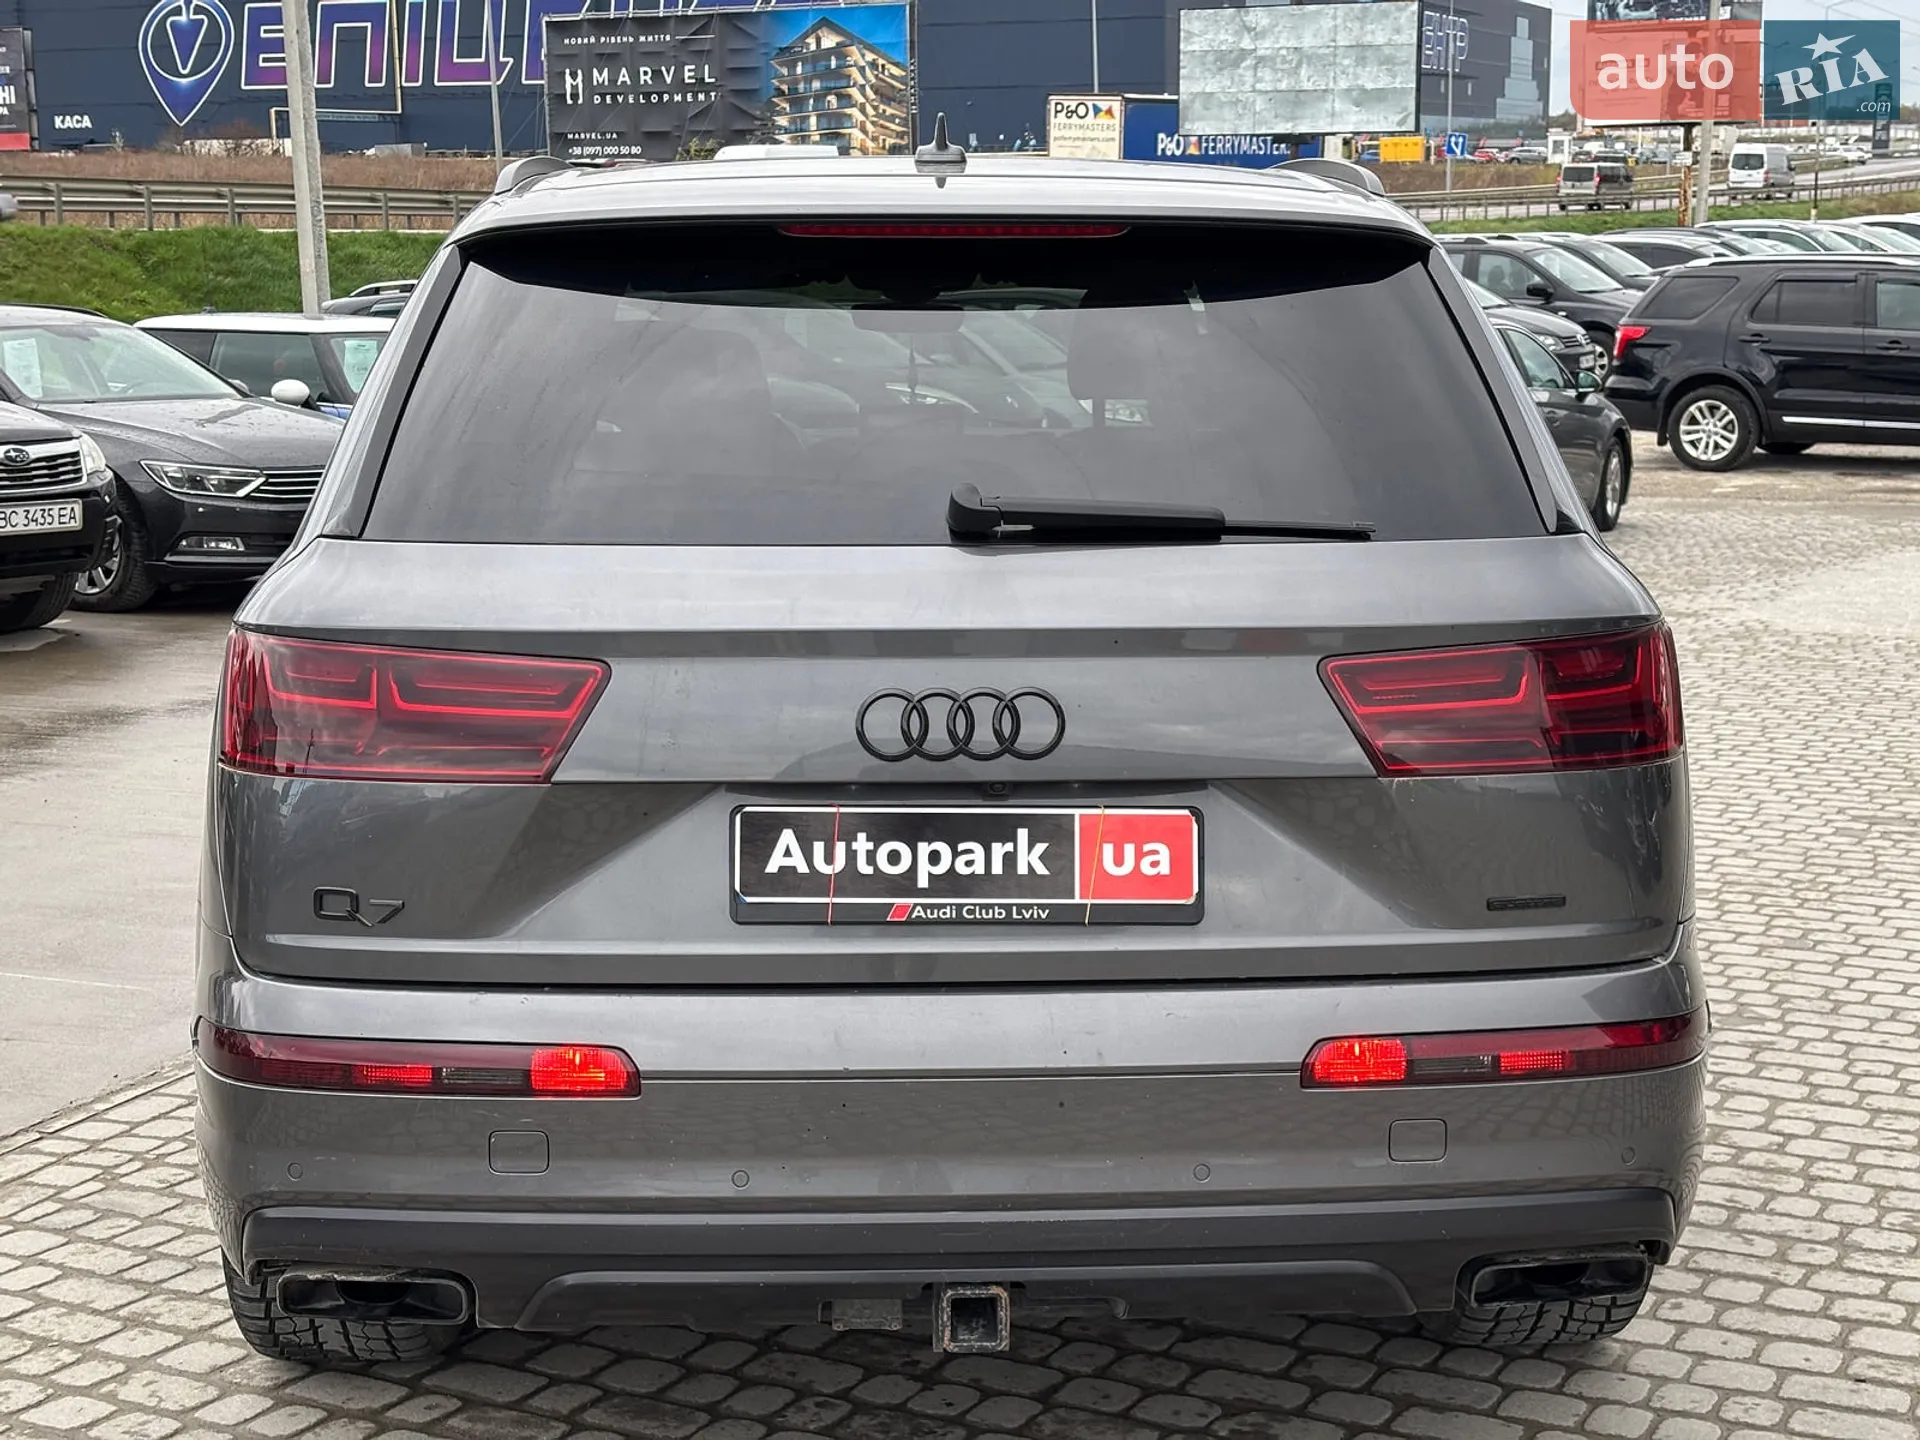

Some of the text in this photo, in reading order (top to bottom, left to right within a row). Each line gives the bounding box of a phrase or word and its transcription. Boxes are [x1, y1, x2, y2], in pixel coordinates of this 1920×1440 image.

[564, 34, 671, 45] НОВИЙ РІВЕНЬ ЖИТТЯ
[592, 64, 716, 86] MARVEL
[593, 92, 717, 104] DEVELOPMENT
[1054, 102, 1090, 120] P&O
[54, 114, 93, 129] КАСА
[1053, 123, 1117, 132] FERRYMASTERS
[567, 132, 618, 140] MARVEL.UA
[568, 146, 582, 155] +38
[603, 145, 619, 155] 000
[620, 145, 630, 155] 50
[1157, 132, 1185, 156] P&O
[23, 508, 54, 527] 3435
[58, 506, 77, 525] EA
[764, 828, 1172, 889] Autopark ua
[313, 886, 405, 927] Q7
[911, 905, 1050, 919] Audi Club Lviv
